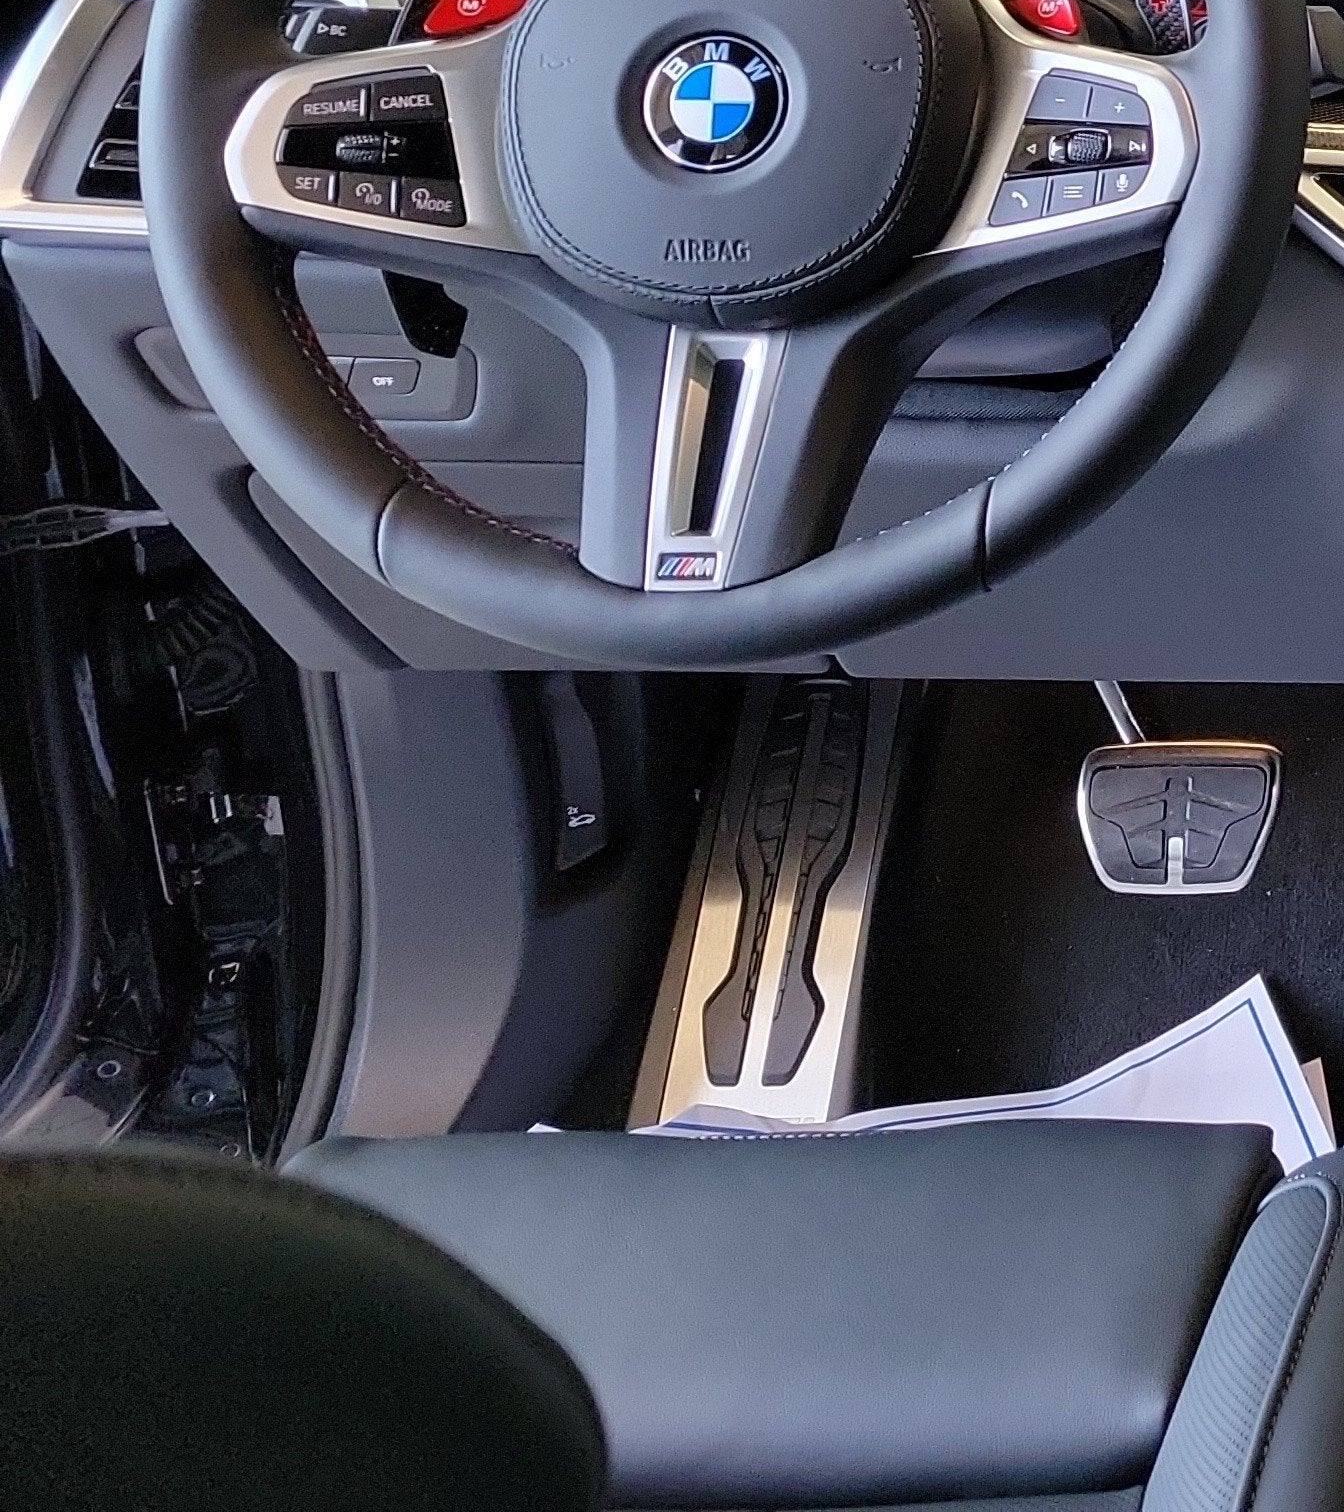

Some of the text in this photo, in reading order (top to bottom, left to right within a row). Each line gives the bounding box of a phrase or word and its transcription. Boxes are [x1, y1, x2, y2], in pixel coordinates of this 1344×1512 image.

[661, 42, 772, 83] BMW
[303, 99, 360, 115] RESUME
[379, 94, 434, 110] CANCEL
[295, 177, 321, 190] SET
[664, 238, 751, 263] AIRBAG
